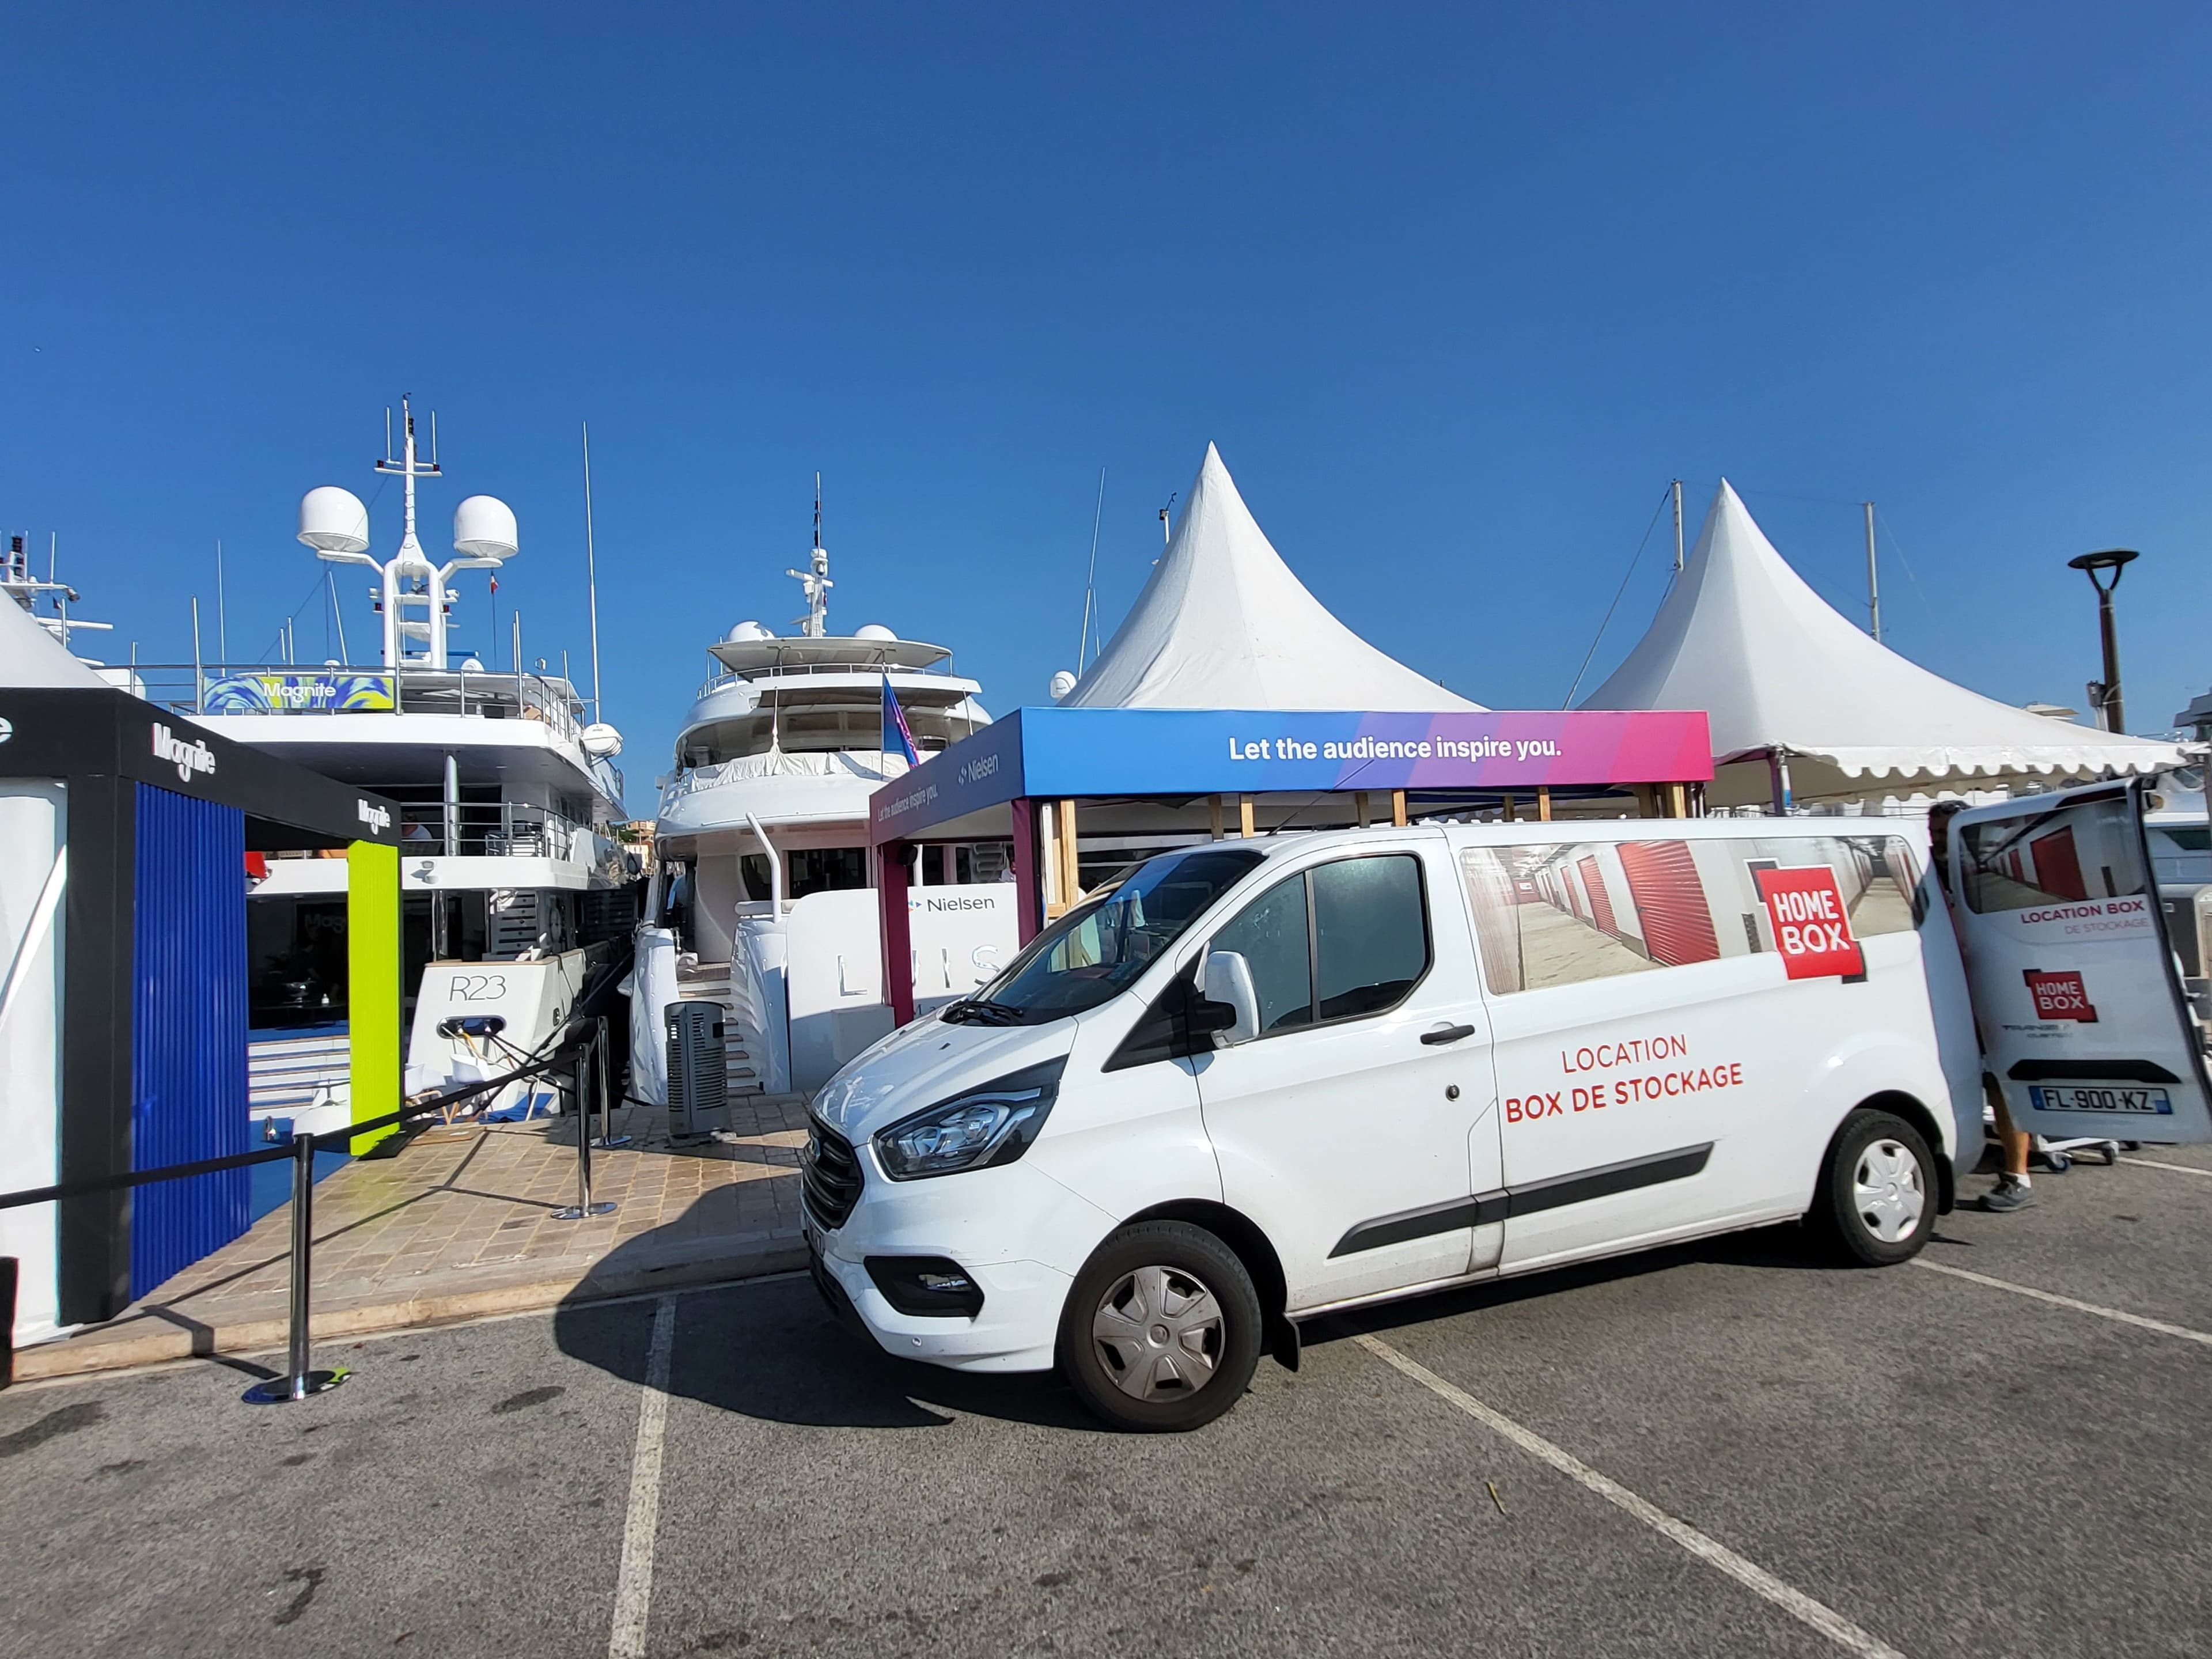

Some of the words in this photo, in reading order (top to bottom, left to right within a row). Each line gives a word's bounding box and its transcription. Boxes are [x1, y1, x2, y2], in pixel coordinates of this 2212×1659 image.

[264, 683, 336, 703] Magnite
[151, 722, 215, 782] Magnite
[1229, 737, 1270, 760] Let
[1276, 738, 1317, 759] the
[1324, 736, 1431, 759] audience
[1436, 736, 1512, 762] inspire
[1516, 737, 1562, 761] you.
[968, 753, 998, 783] Nielsen
[891, 797, 909, 816] audience
[909, 786, 926, 811] inspire
[358, 798, 390, 835] Magnite
[927, 897, 995, 912] Nielsen
[1772, 890, 1839, 922] HOME
[2020, 905, 2102, 924] LOCATION
[2106, 900, 2145, 914] BOX
[1781, 922, 1850, 955] BOX
[2065, 925, 2082, 935] DE
[2084, 918, 2149, 933] STOCKAGE
[449, 975, 506, 1001] R23
[2035, 982, 2080, 995] HOME
[2039, 996, 2085, 1010] BOX
[1562, 1034, 1687, 1073] LOCATION
[1506, 1091, 1563, 1123] BOX
[1572, 1085, 1606, 1112] DE
[1615, 1063, 1743, 1104] STOCKAGE
[2043, 1089, 2154, 1111] FL-900-KZ
